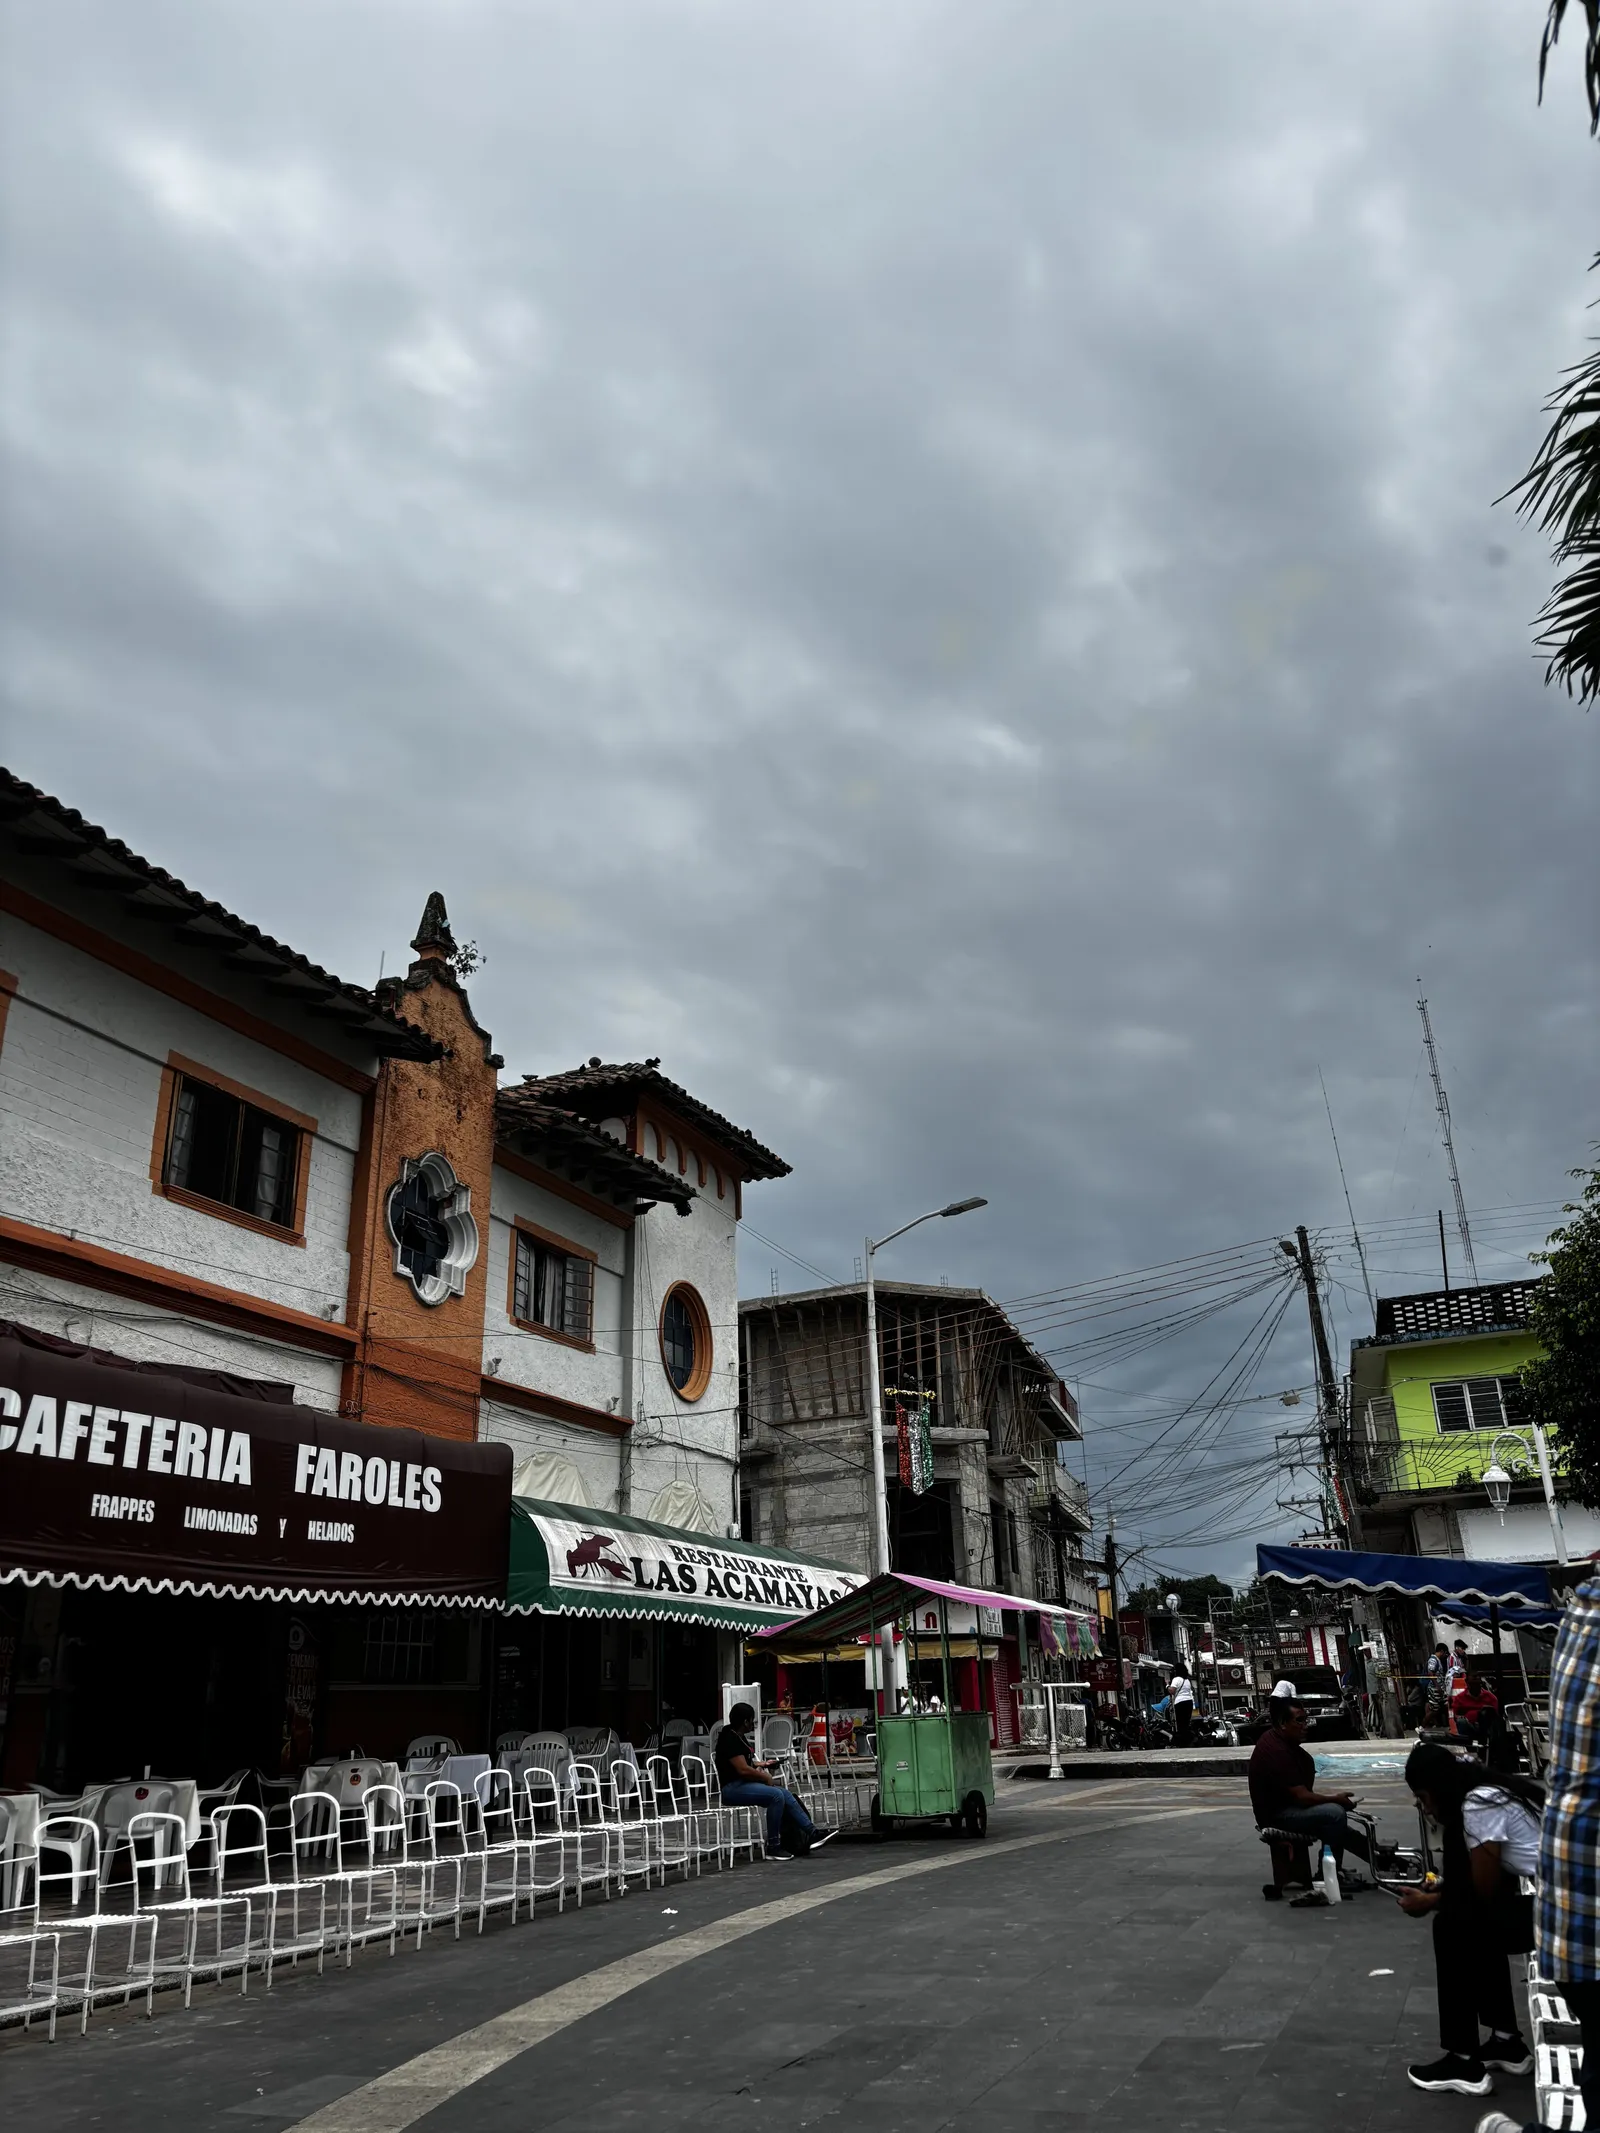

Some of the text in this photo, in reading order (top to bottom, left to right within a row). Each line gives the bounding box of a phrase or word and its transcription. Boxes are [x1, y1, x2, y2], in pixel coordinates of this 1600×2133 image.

[0, 1387, 442, 1513] CAFETERIA FAROLES
[91, 1494, 354, 1543] FRAPPES LIMONADAS Y HELADOS
[630, 1557, 697, 1594] LAS
[668, 1545, 808, 1583] RESTAURANTE
